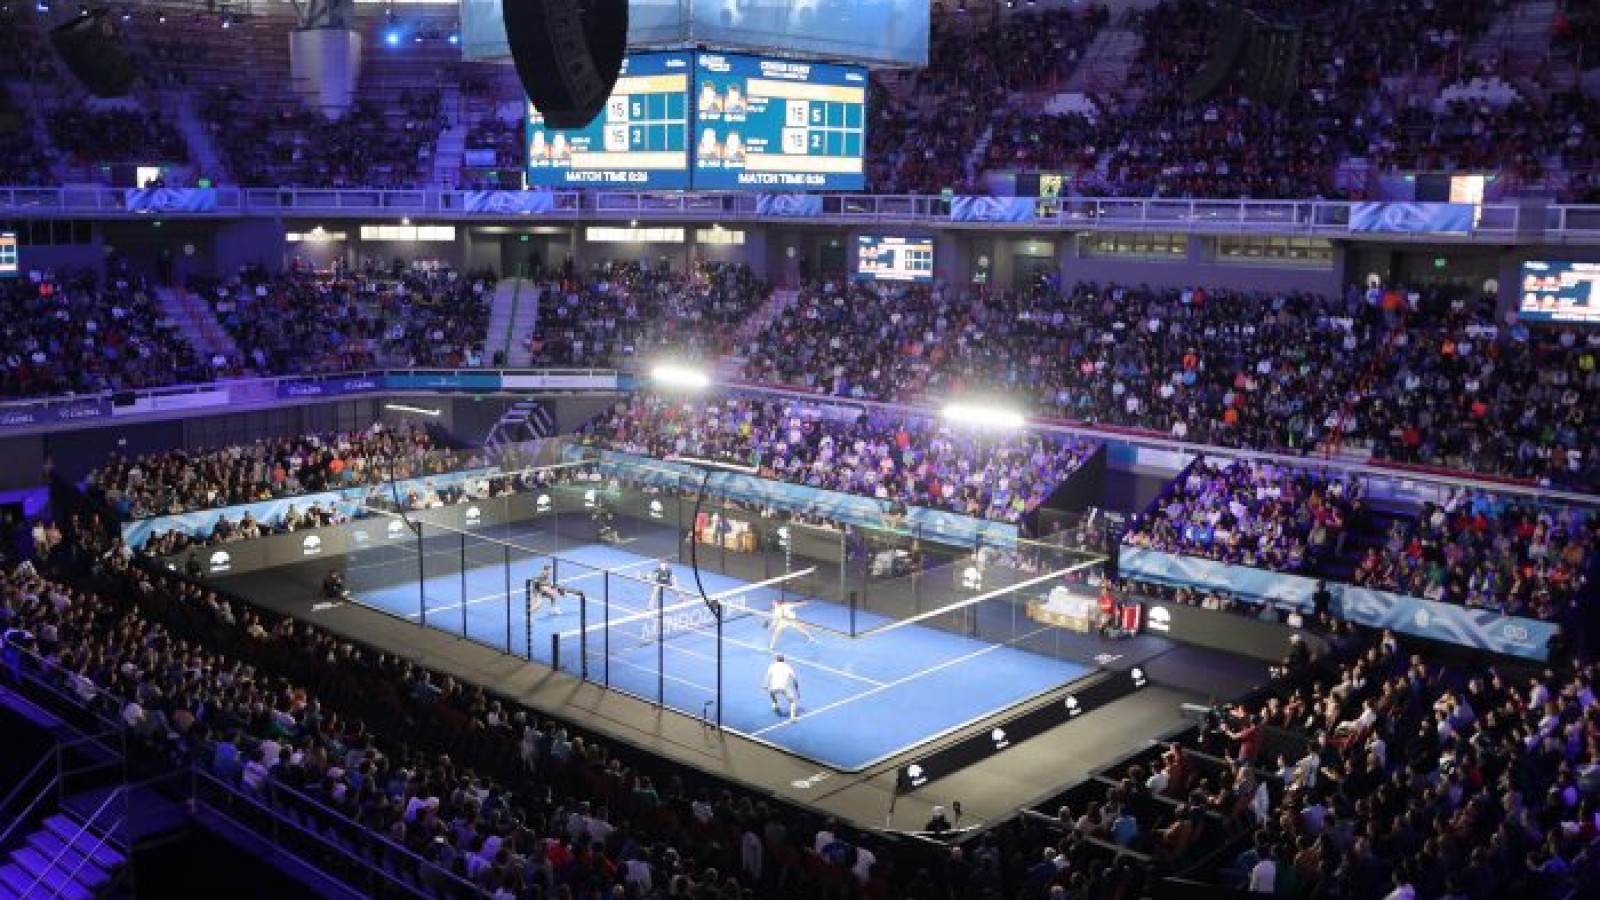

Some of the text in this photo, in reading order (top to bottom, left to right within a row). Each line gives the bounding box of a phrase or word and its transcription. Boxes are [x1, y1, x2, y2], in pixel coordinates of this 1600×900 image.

[632, 102, 641, 118] 5
[812, 109, 822, 123] 5
[632, 129, 641, 145] 2
[811, 134, 822, 148] 2
[566, 171, 602, 182] MATCH
[603, 171, 627, 182] TIME
[738, 173, 778, 184] MATCH
[779, 173, 805, 184] TIME
